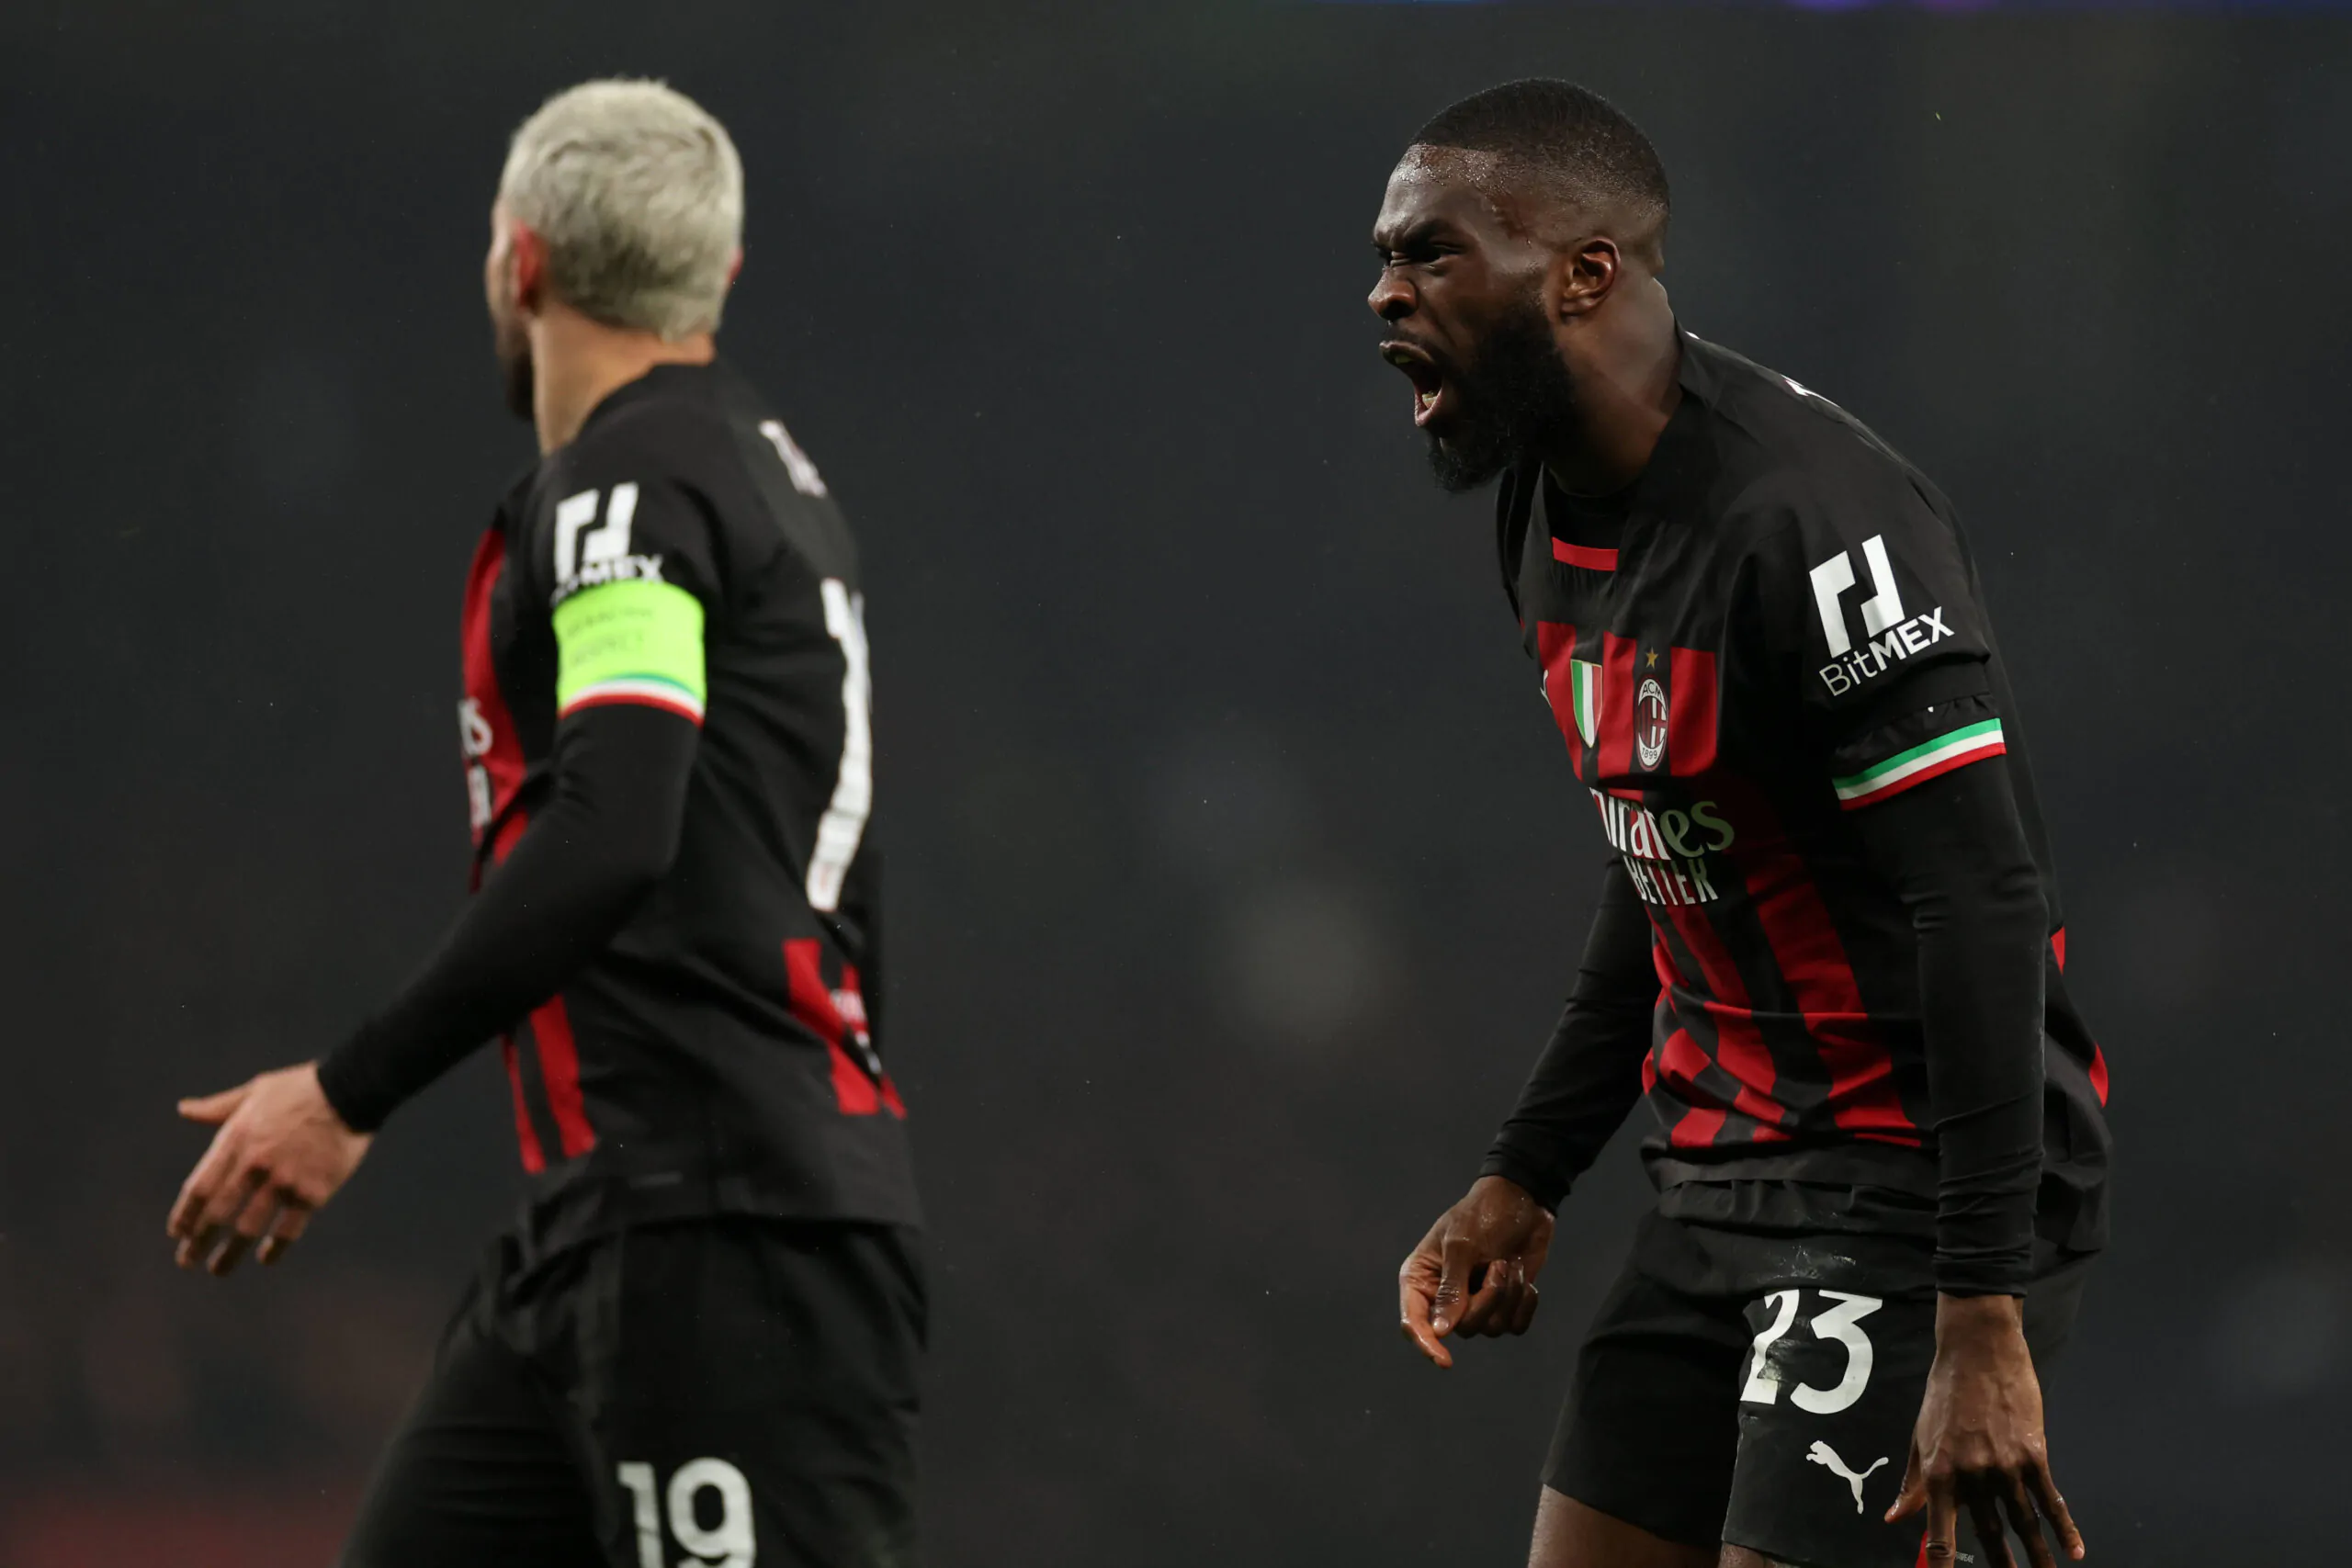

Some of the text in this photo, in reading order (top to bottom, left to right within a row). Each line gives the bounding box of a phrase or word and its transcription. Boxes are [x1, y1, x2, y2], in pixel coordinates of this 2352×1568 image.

[1641, 682, 1663, 701] ACM
[1819, 606, 1955, 696] BitMEX
[1642, 748, 1658, 761] 1899
[1740, 1289, 1883, 1415] 23
[617, 1457, 756, 1568] 19
